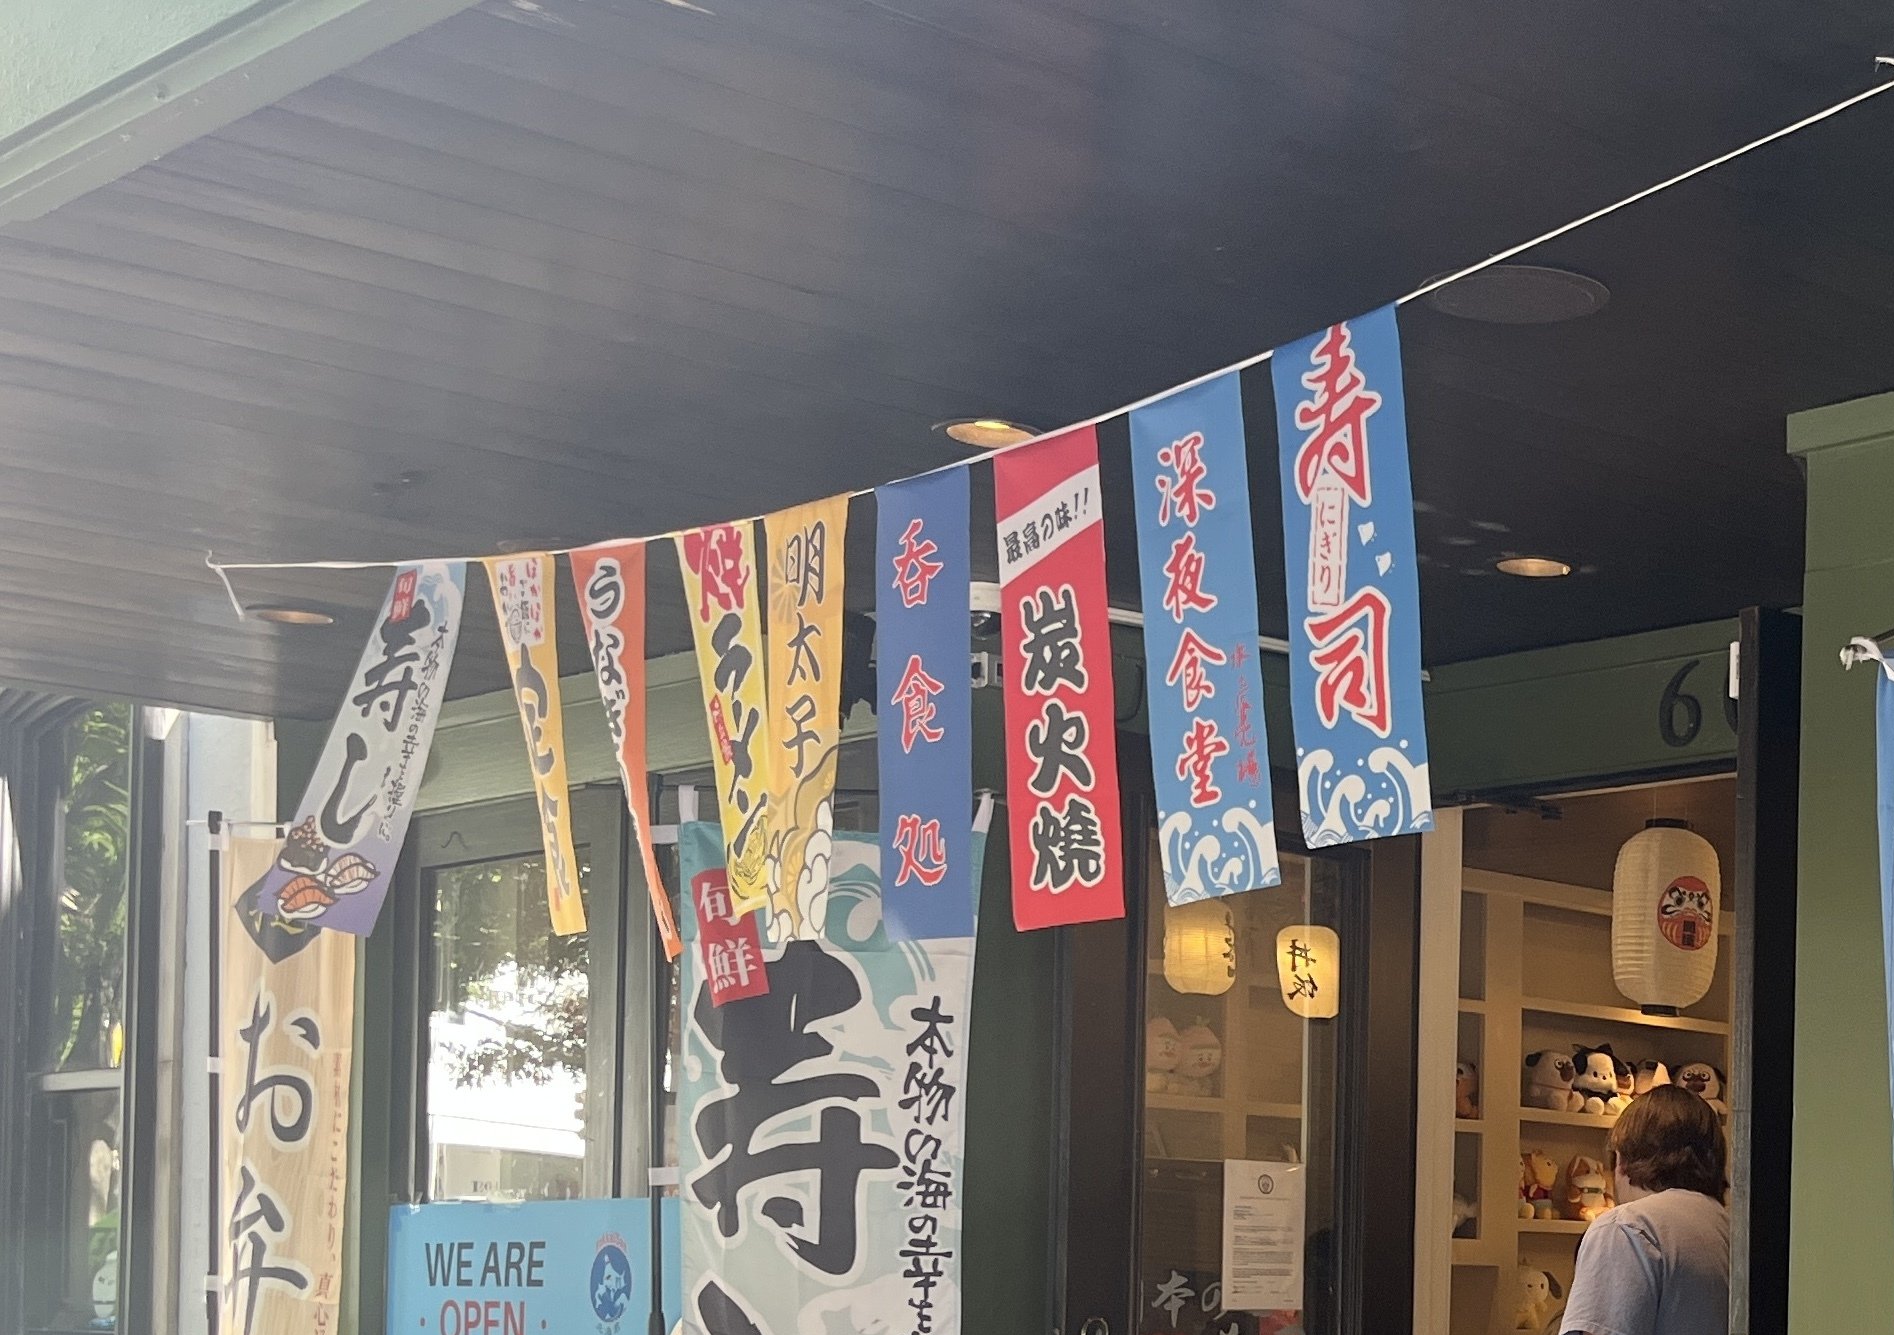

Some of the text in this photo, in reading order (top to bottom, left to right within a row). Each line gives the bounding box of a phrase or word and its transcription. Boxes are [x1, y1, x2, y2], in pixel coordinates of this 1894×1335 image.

[1157, 432, 1229, 806] 深夜食堂
[1299, 323, 1387, 734] 寿司
[1320, 499, 1338, 594] にぎり
[782, 520, 827, 779] 明太子
[699, 882, 758, 993] 旬鮮
[425, 1241, 474, 1288] WE
[480, 1241, 547, 1288] ARE
